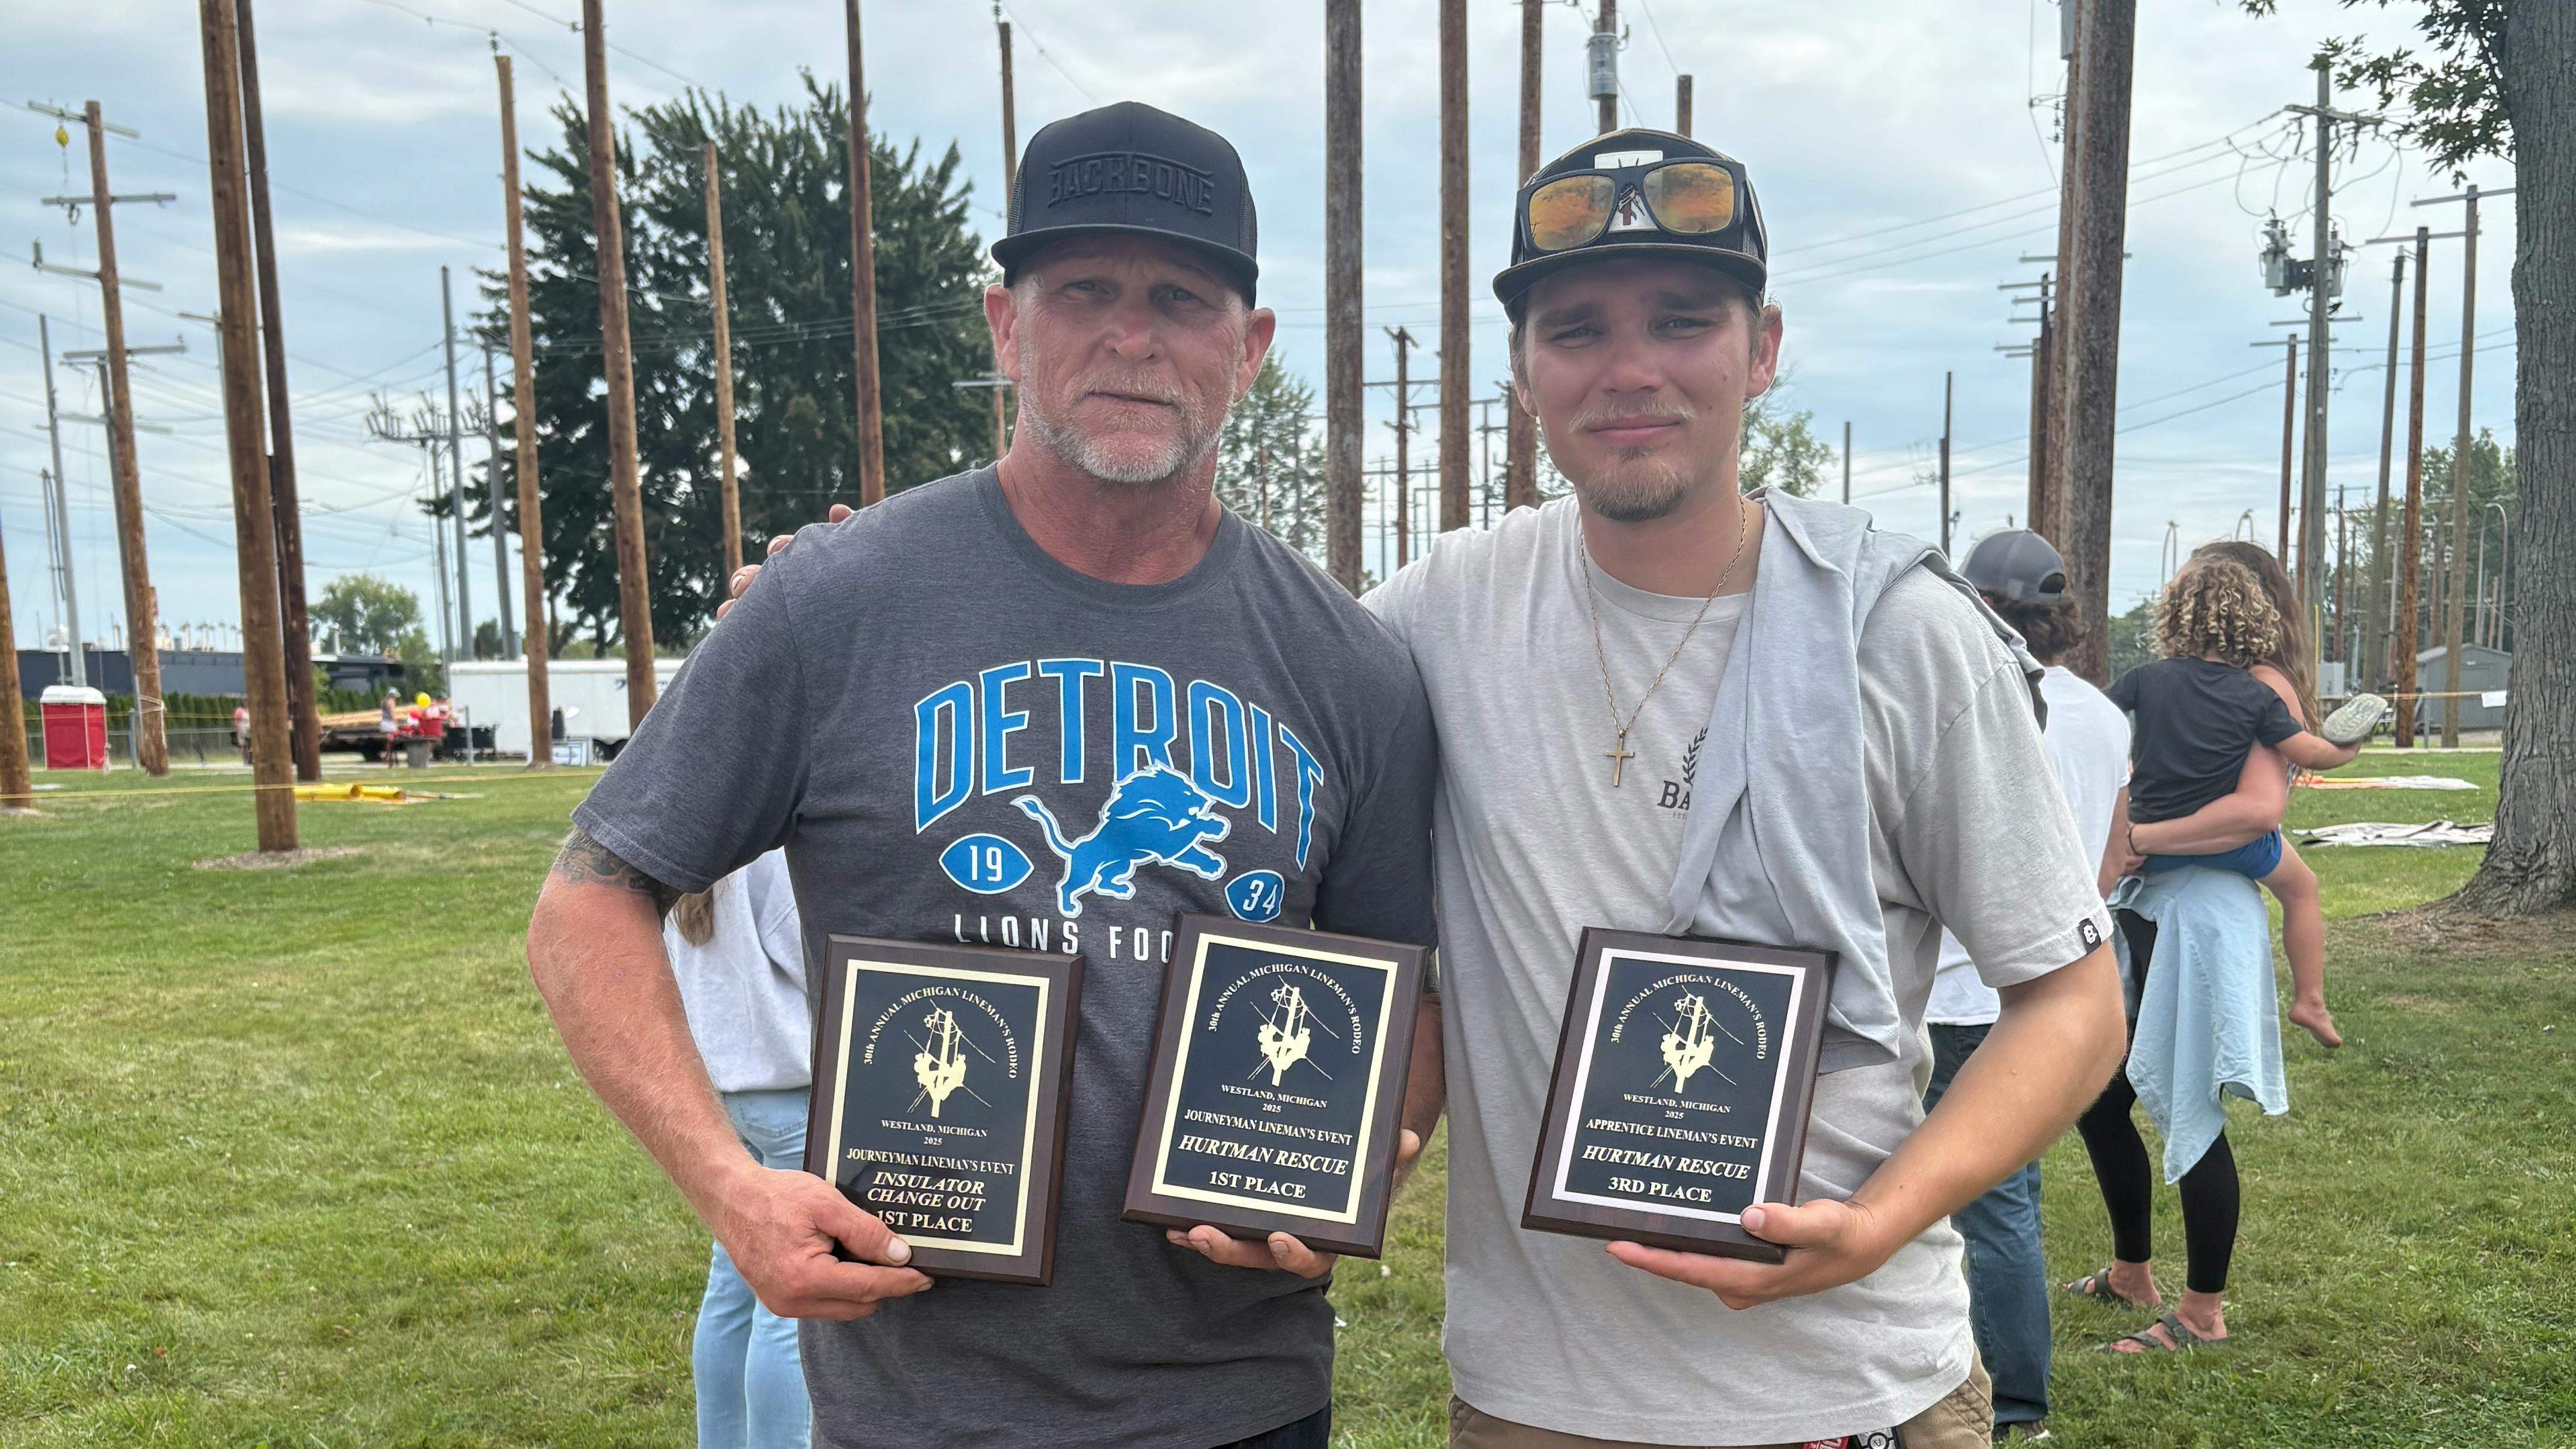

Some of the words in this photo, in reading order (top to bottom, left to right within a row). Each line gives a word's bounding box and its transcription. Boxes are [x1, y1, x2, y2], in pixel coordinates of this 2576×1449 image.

[1047, 155, 1215, 216] BACKBONE
[914, 658, 1323, 872] DETROIT
[969, 845, 1003, 882] 19
[1242, 880, 1278, 915] 34
[954, 914, 1079, 955] LIONS
[1208, 1012, 1221, 1032] 30th
[1218, 975, 1250, 1011] ANNUAL
[1249, 964, 1310, 979] MICHIGAN
[1310, 969, 1357, 1015] LINEMAN'S
[1351, 1015, 1362, 1055] RODEO
[1611, 1024, 1624, 1044] 30th
[1618, 987, 1654, 1023] ANNUAL
[1652, 974, 1713, 991] MICHIGAN
[1714, 978, 1762, 1021] LINEMAN'S
[1755, 1022, 1767, 1060] RODEO
[864, 1043, 875, 1064] 30th
[870, 1002, 902, 1042] ANNUAL
[901, 987, 961, 1006] MICHIGAN
[961, 990, 1011, 1037] LINEMAN'S
[1005, 1037, 1018, 1079] RODEO
[1262, 1103, 1281, 1113] 2025
[1277, 1093, 1328, 1108] MICHIGAN
[1664, 1110, 1684, 1120] 2025
[1679, 1100, 1731, 1113] MICHIGAN
[924, 1136, 942, 1145] 2025
[937, 1126, 988, 1138] MICHIGAN
[1184, 1109, 1257, 1130] JOURNEYMAN
[1259, 1121, 1316, 1140] LINEMAN'S
[1317, 1130, 1352, 1145] EVENT
[1586, 1118, 1655, 1136] APPRENTICE
[1656, 1127, 1717, 1144] LINEMAN'S
[1719, 1134, 1758, 1149] EVENT
[847, 1148, 919, 1166] JOURNEYMAN
[921, 1155, 978, 1172] LINEMAN'S
[980, 1161, 1015, 1175] EVENT
[1178, 1135, 1274, 1163] HURTMAN
[1274, 1150, 1349, 1175] RESCUE
[1581, 1145, 1677, 1170] HURTMAN
[1676, 1157, 1751, 1180] RESCUE
[872, 1171, 985, 1195] INSULATOR
[1209, 1171, 1242, 1187] 1ST
[1244, 1175, 1307, 1198] PLACE
[1608, 1177, 1645, 1193] 3RD
[1648, 1181, 1712, 1203] PLACE
[867, 1187, 943, 1207] CHANGE
[947, 1195, 986, 1212] OUT
[877, 1210, 907, 1225] 1ST
[912, 1213, 973, 1233] PLACE
